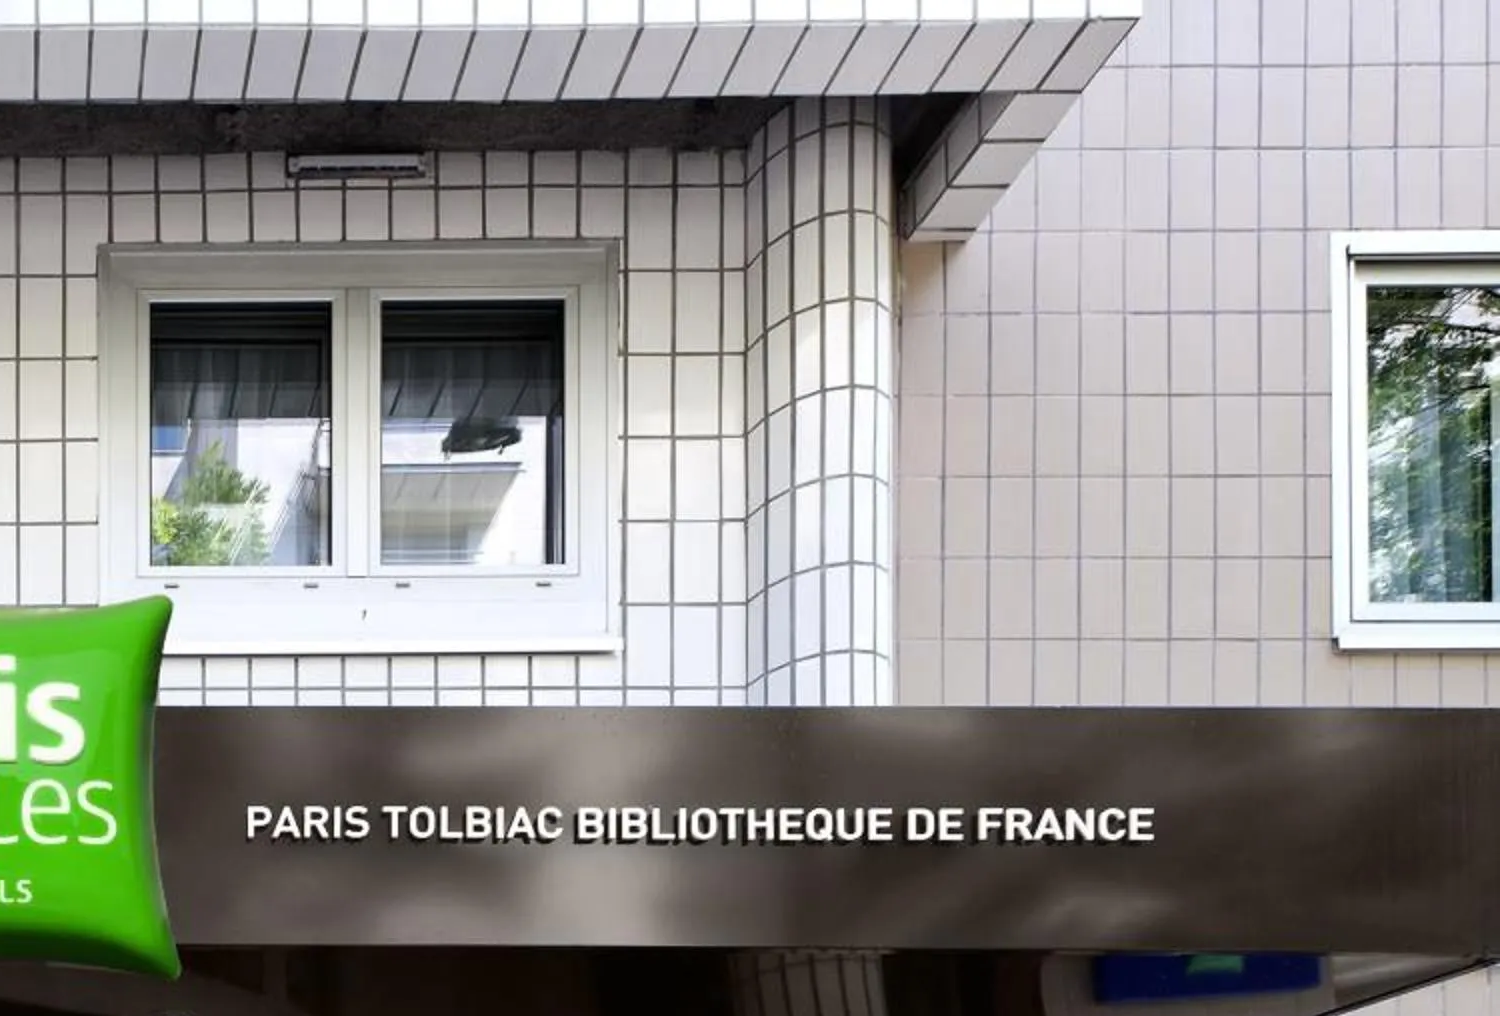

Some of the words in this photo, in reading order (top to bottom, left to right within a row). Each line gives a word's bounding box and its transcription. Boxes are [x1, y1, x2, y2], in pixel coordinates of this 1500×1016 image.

[245, 804, 371, 840] PARIS
[381, 805, 564, 841] TOLBIAC
[576, 806, 893, 843] BIBLIOTHEQUE
[906, 806, 964, 842] DE
[977, 806, 1156, 842] FRANCE
